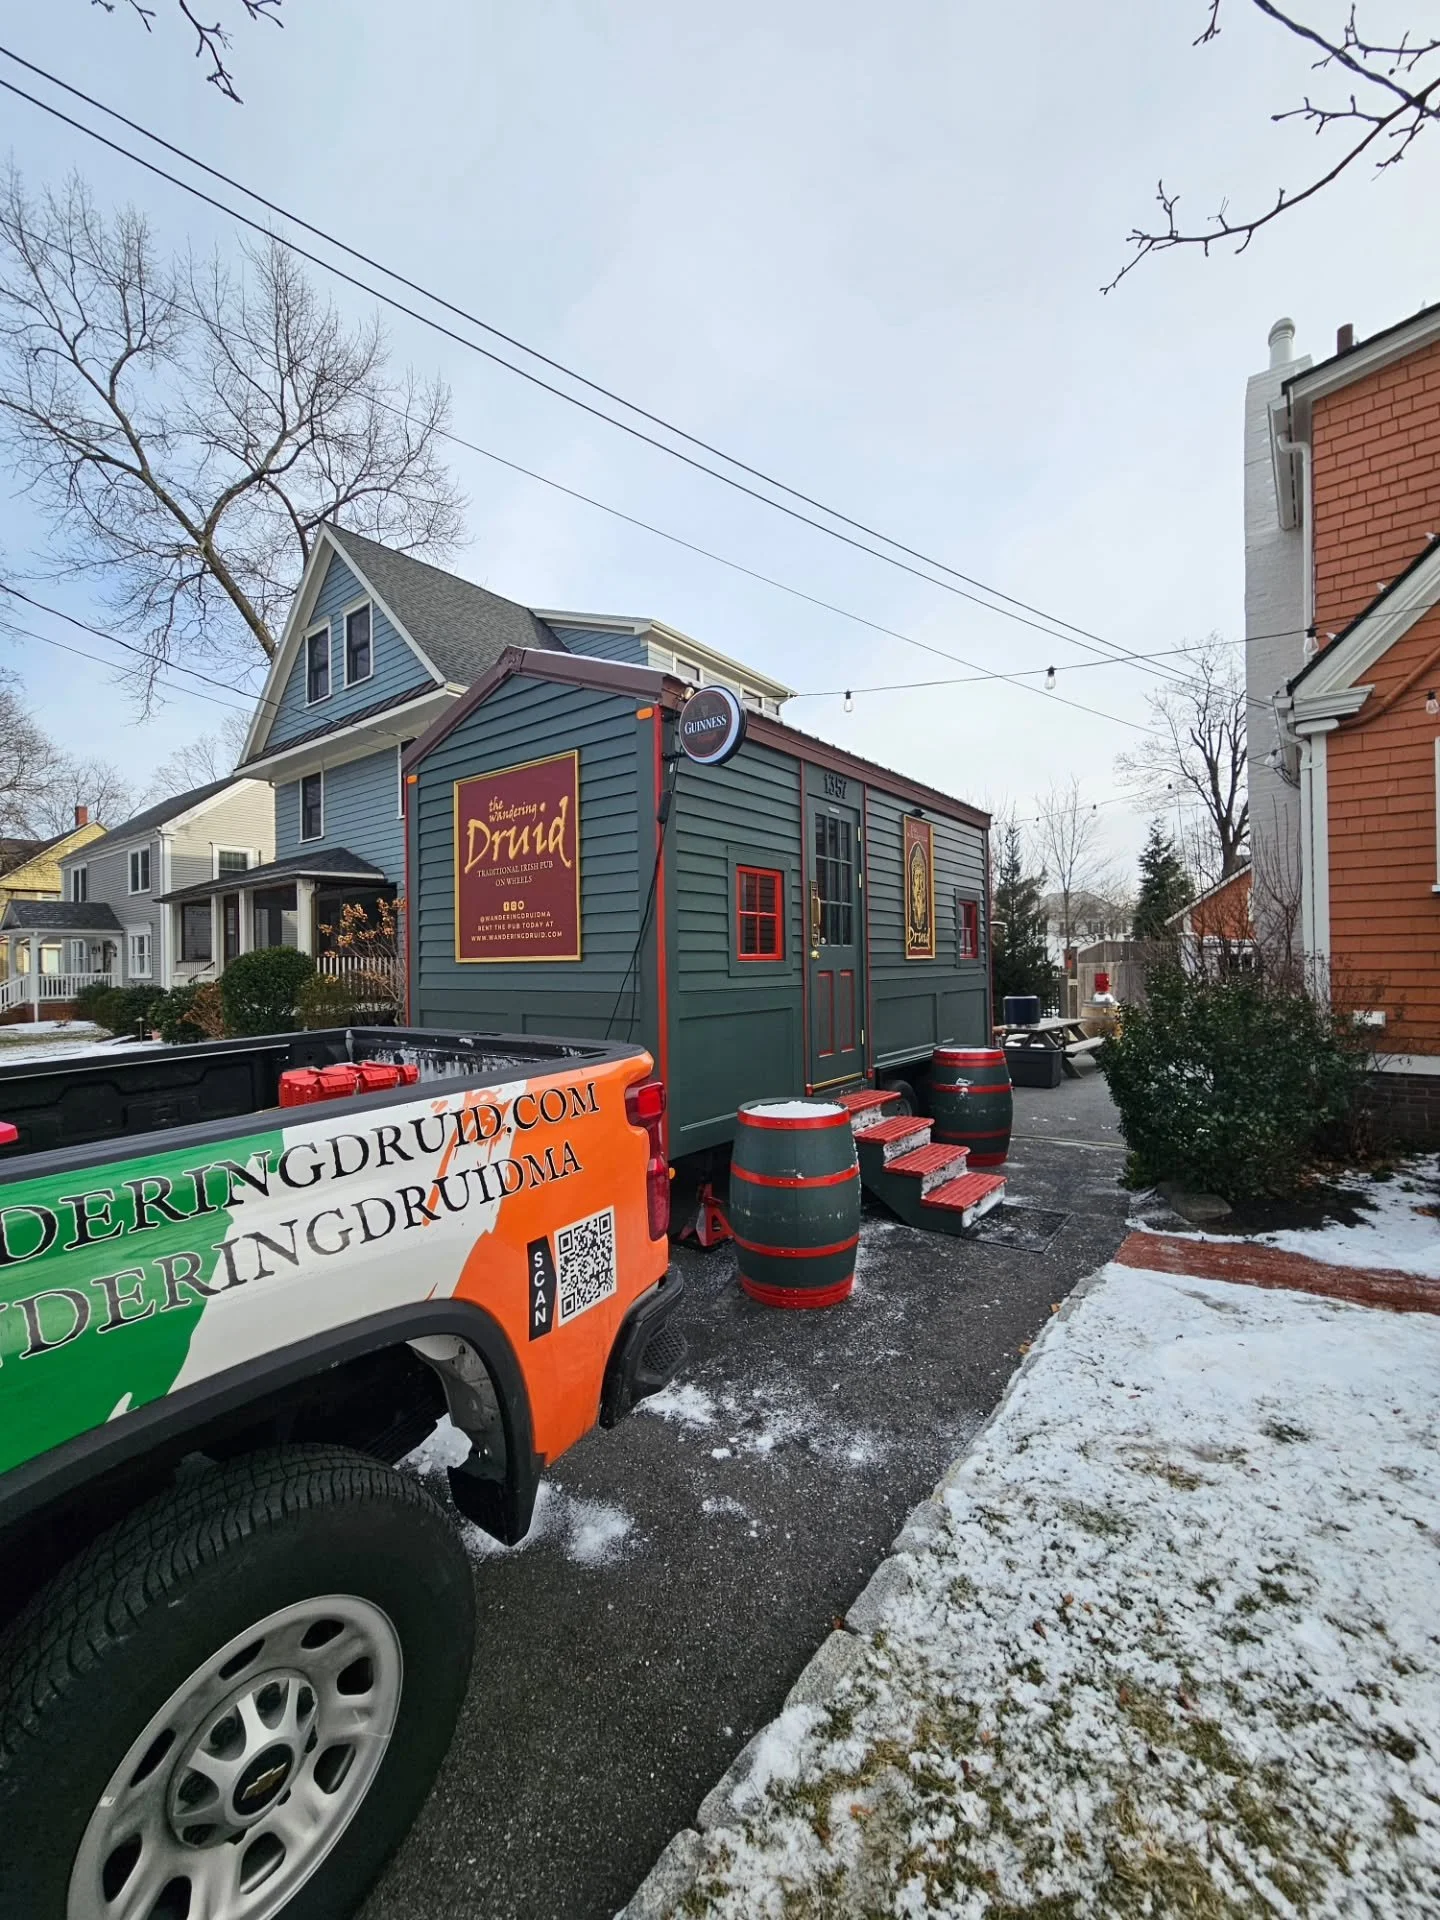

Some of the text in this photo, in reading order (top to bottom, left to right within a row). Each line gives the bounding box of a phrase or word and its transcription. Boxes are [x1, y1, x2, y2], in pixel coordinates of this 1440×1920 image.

[684, 714, 727, 735] GUINNESS
[824, 773, 847, 800] 1357
[489, 796, 504, 812] the
[489, 802, 537, 822] wandering
[464, 796, 572, 874] Druid
[477, 860, 553, 878] TRADITIONAL IRISH PUB
[495, 875, 533, 887] ON WHEELS
[480, 911, 551, 923] @WANDERINGDRUIDMA
[471, 931, 563, 942] WWW.WANDERINGDRUID.COM
[477, 924, 493, 932] RENT
[494, 923, 505, 931] THE
[507, 922, 520, 930] PUB
[0, 1140, 583, 1366] DERINGDRUIDMA
[533, 1251, 547, 1327] SCAN
